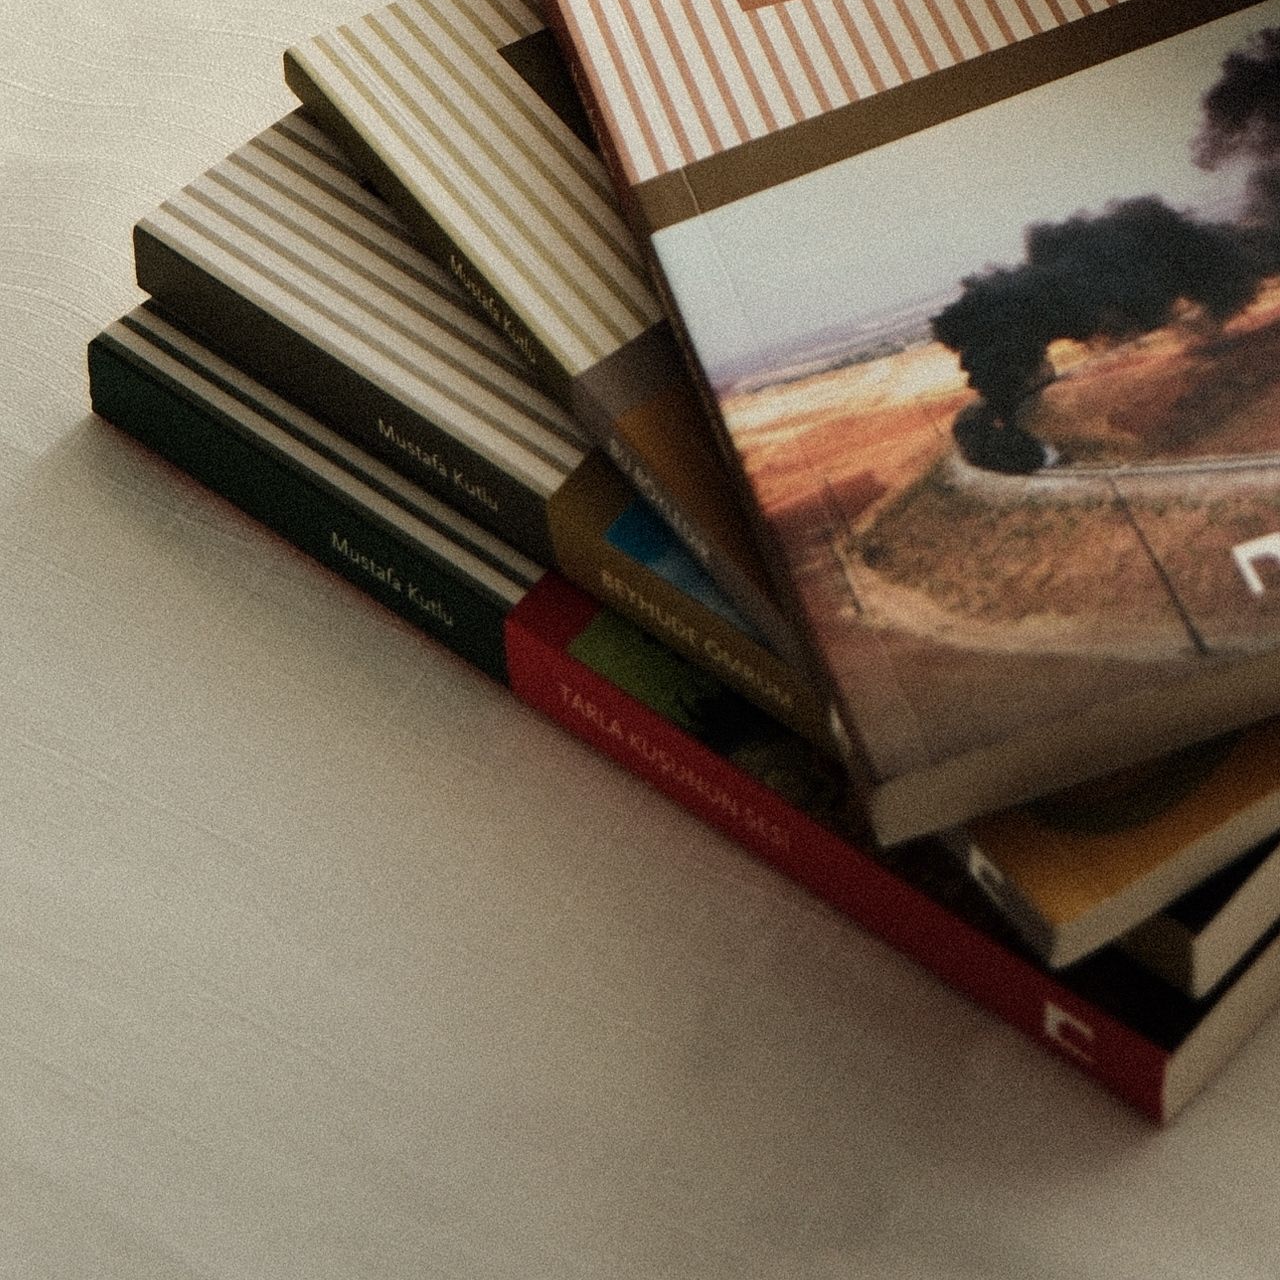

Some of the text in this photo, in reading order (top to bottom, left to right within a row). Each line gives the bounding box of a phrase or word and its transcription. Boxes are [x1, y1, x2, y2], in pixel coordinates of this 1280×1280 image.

[377, 418, 501, 513] Mustafa Kutlu
[331, 531, 456, 629] Mustafa Kutlu
[558, 682, 625, 738] TARLA
